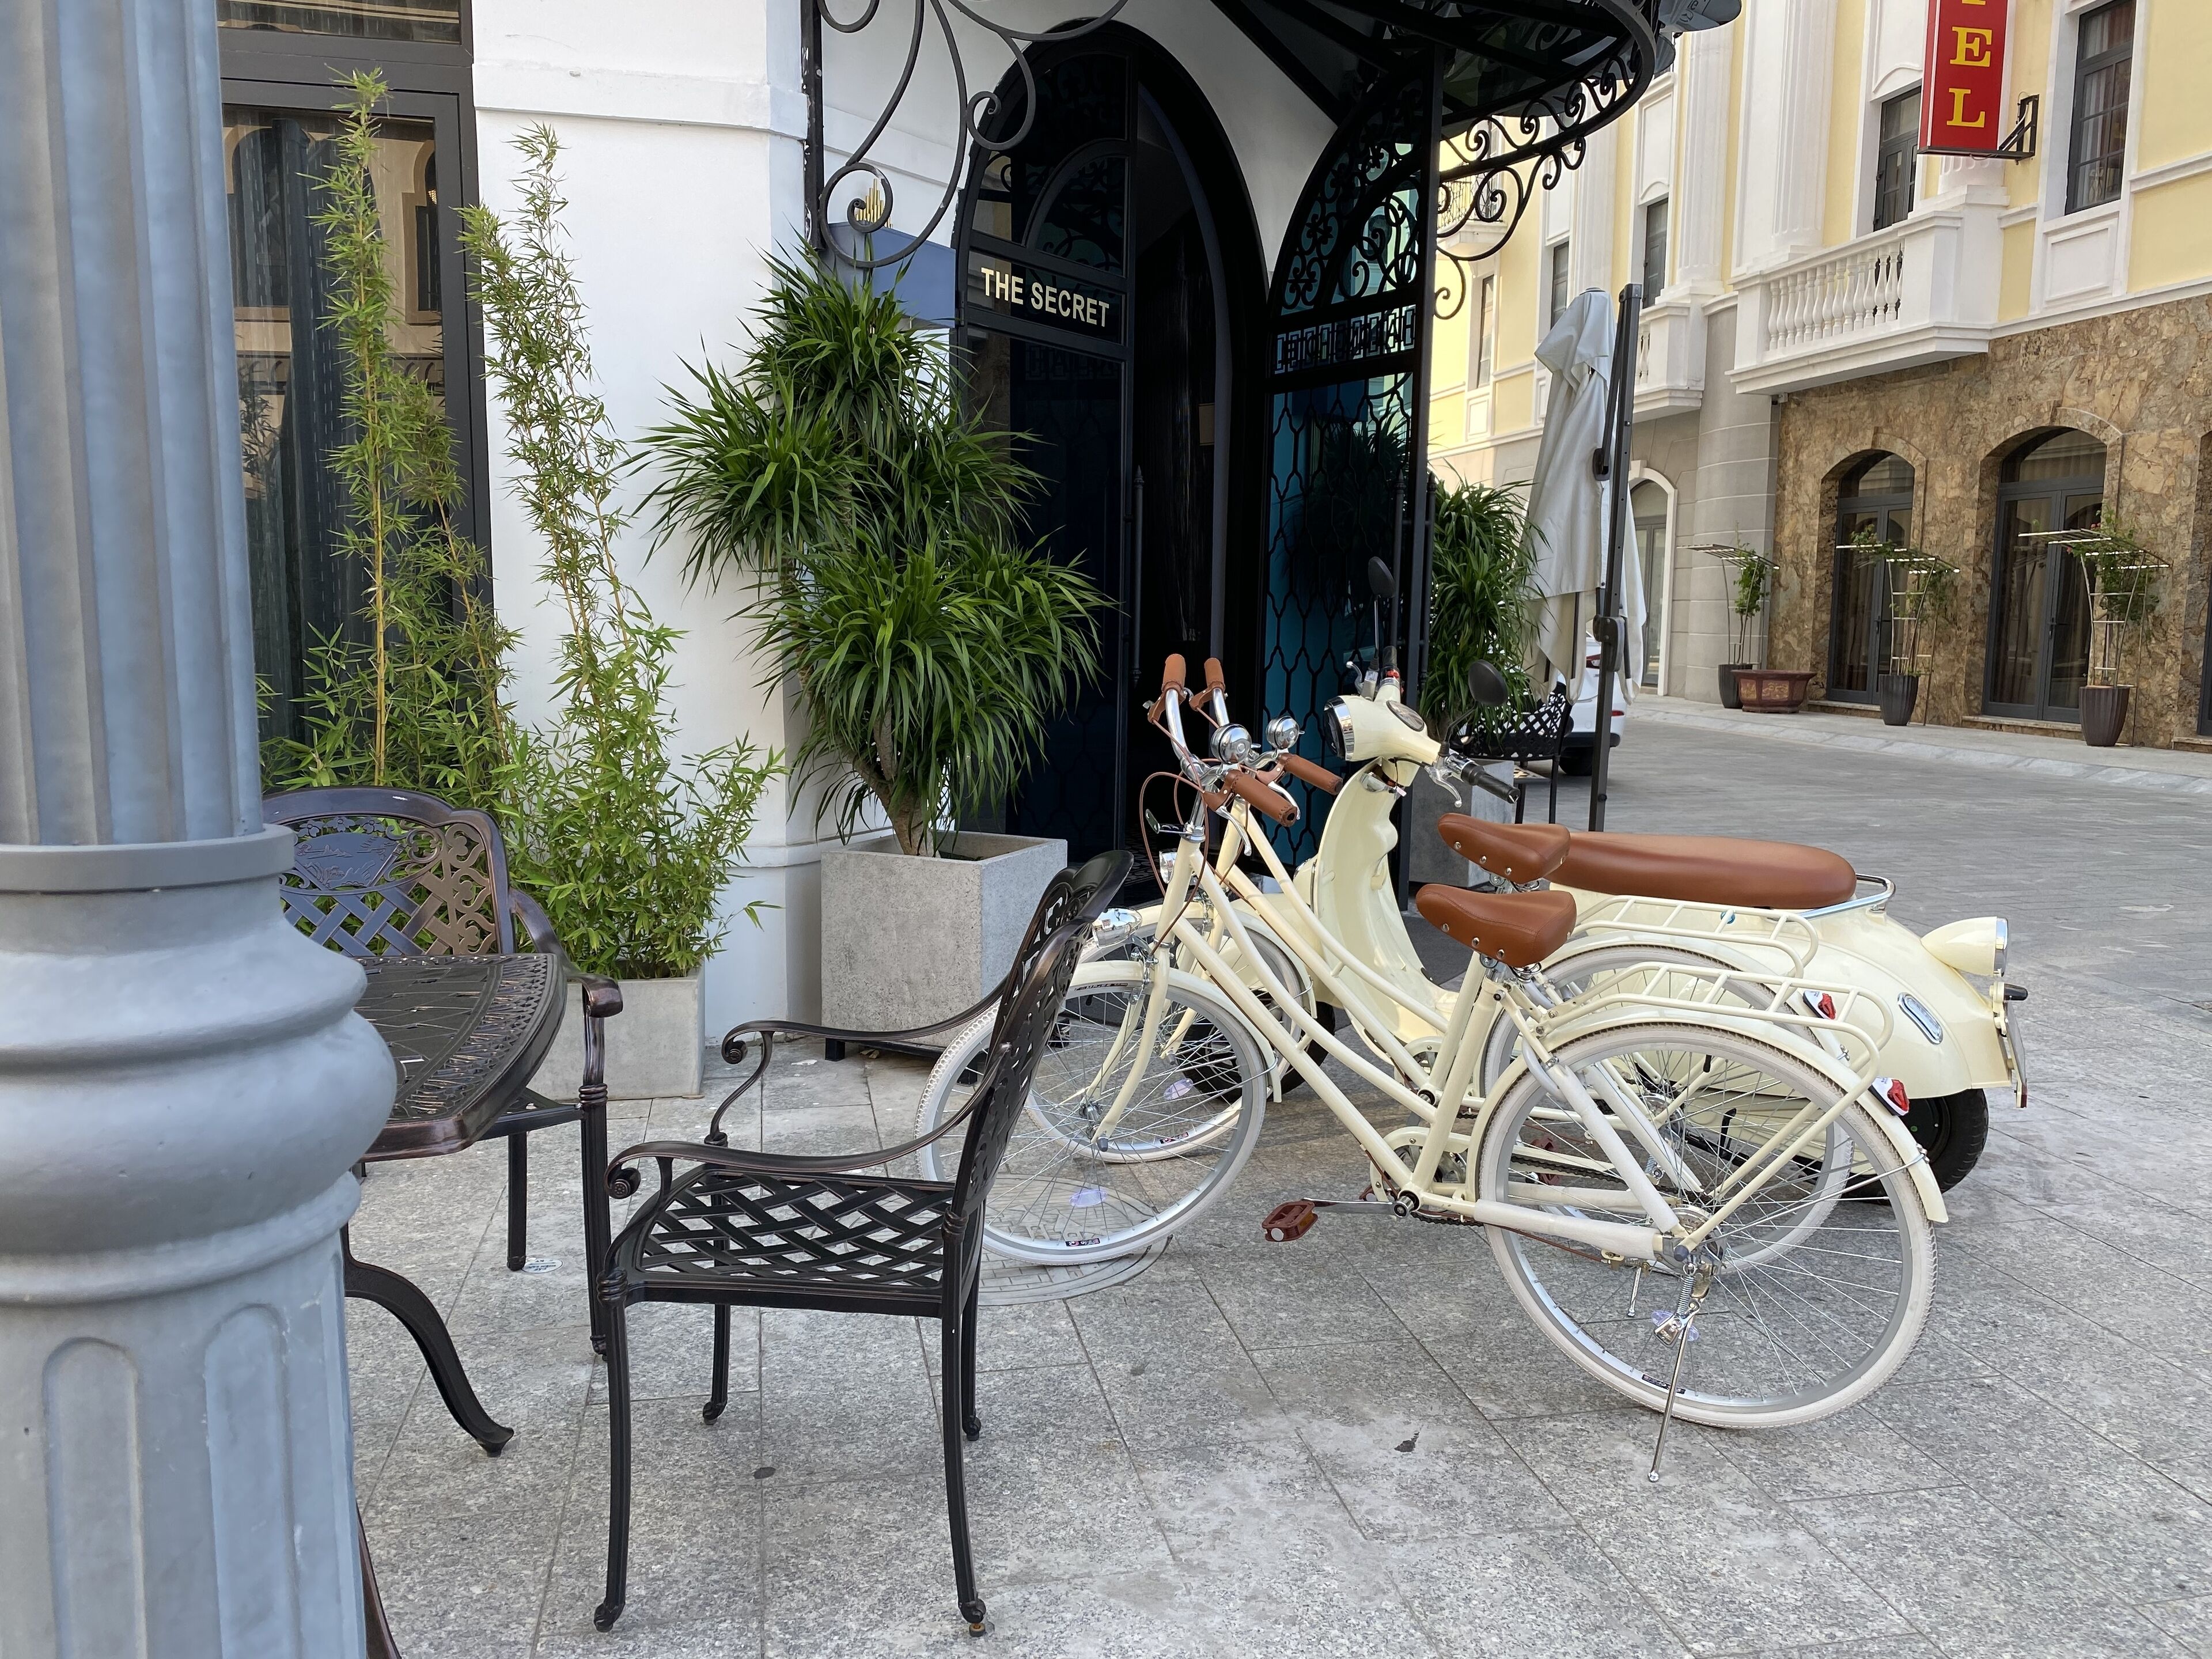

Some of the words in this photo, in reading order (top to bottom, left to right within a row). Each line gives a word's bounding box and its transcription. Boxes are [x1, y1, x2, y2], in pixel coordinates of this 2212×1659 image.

[1946, 0, 1992, 128] EL
[981, 267, 1024, 305] THE
[1031, 282, 1109, 327] SECRET
